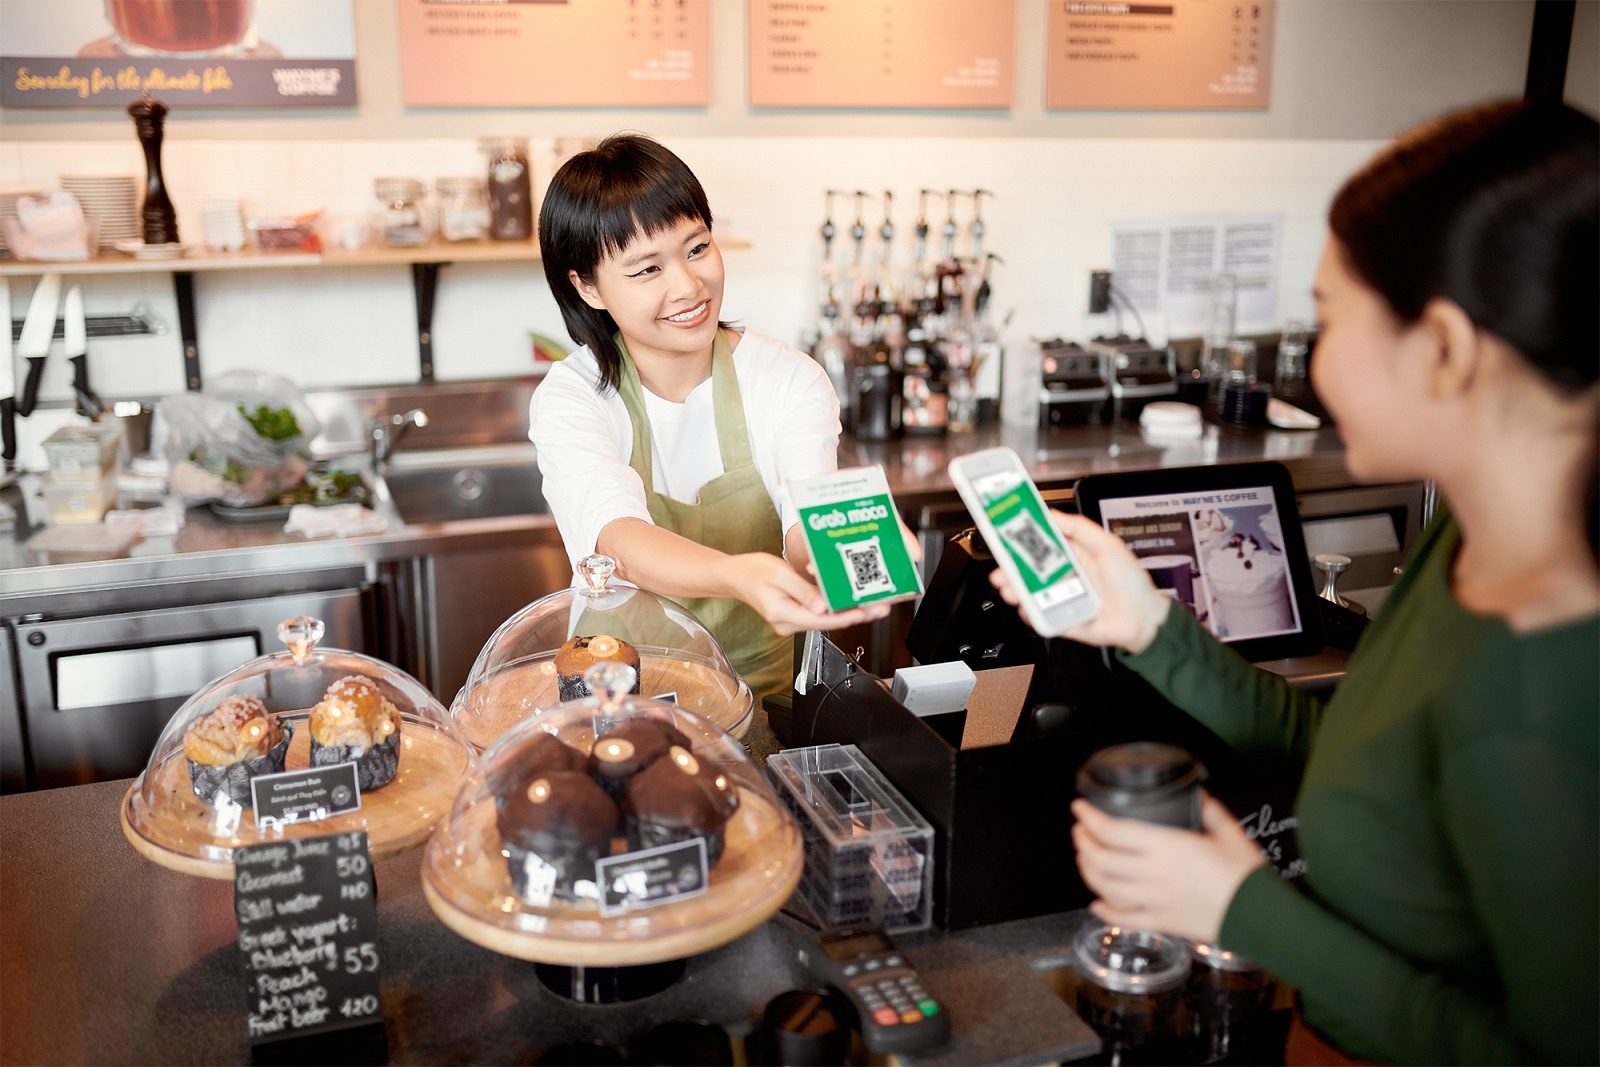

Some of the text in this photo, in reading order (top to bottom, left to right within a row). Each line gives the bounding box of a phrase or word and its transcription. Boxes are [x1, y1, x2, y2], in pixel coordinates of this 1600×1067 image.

[15, 65, 90, 99] Searching
[91, 66, 116, 94] for
[116, 64, 141, 91] the
[142, 65, 202, 91] ultimate
[1134, 501, 1169, 510] Welcome
[1183, 495, 1222, 506] WAYNE'S
[1224, 492, 1259, 502] COFFEE
[808, 508, 847, 532] Grab
[847, 504, 889, 525] moca
[273, 778, 322, 791] Cinnamon Bun
[336, 853, 367, 878] 50
[343, 942, 379, 975] 55
[257, 965, 319, 995] Peach
[259, 985, 327, 1014] Mango
